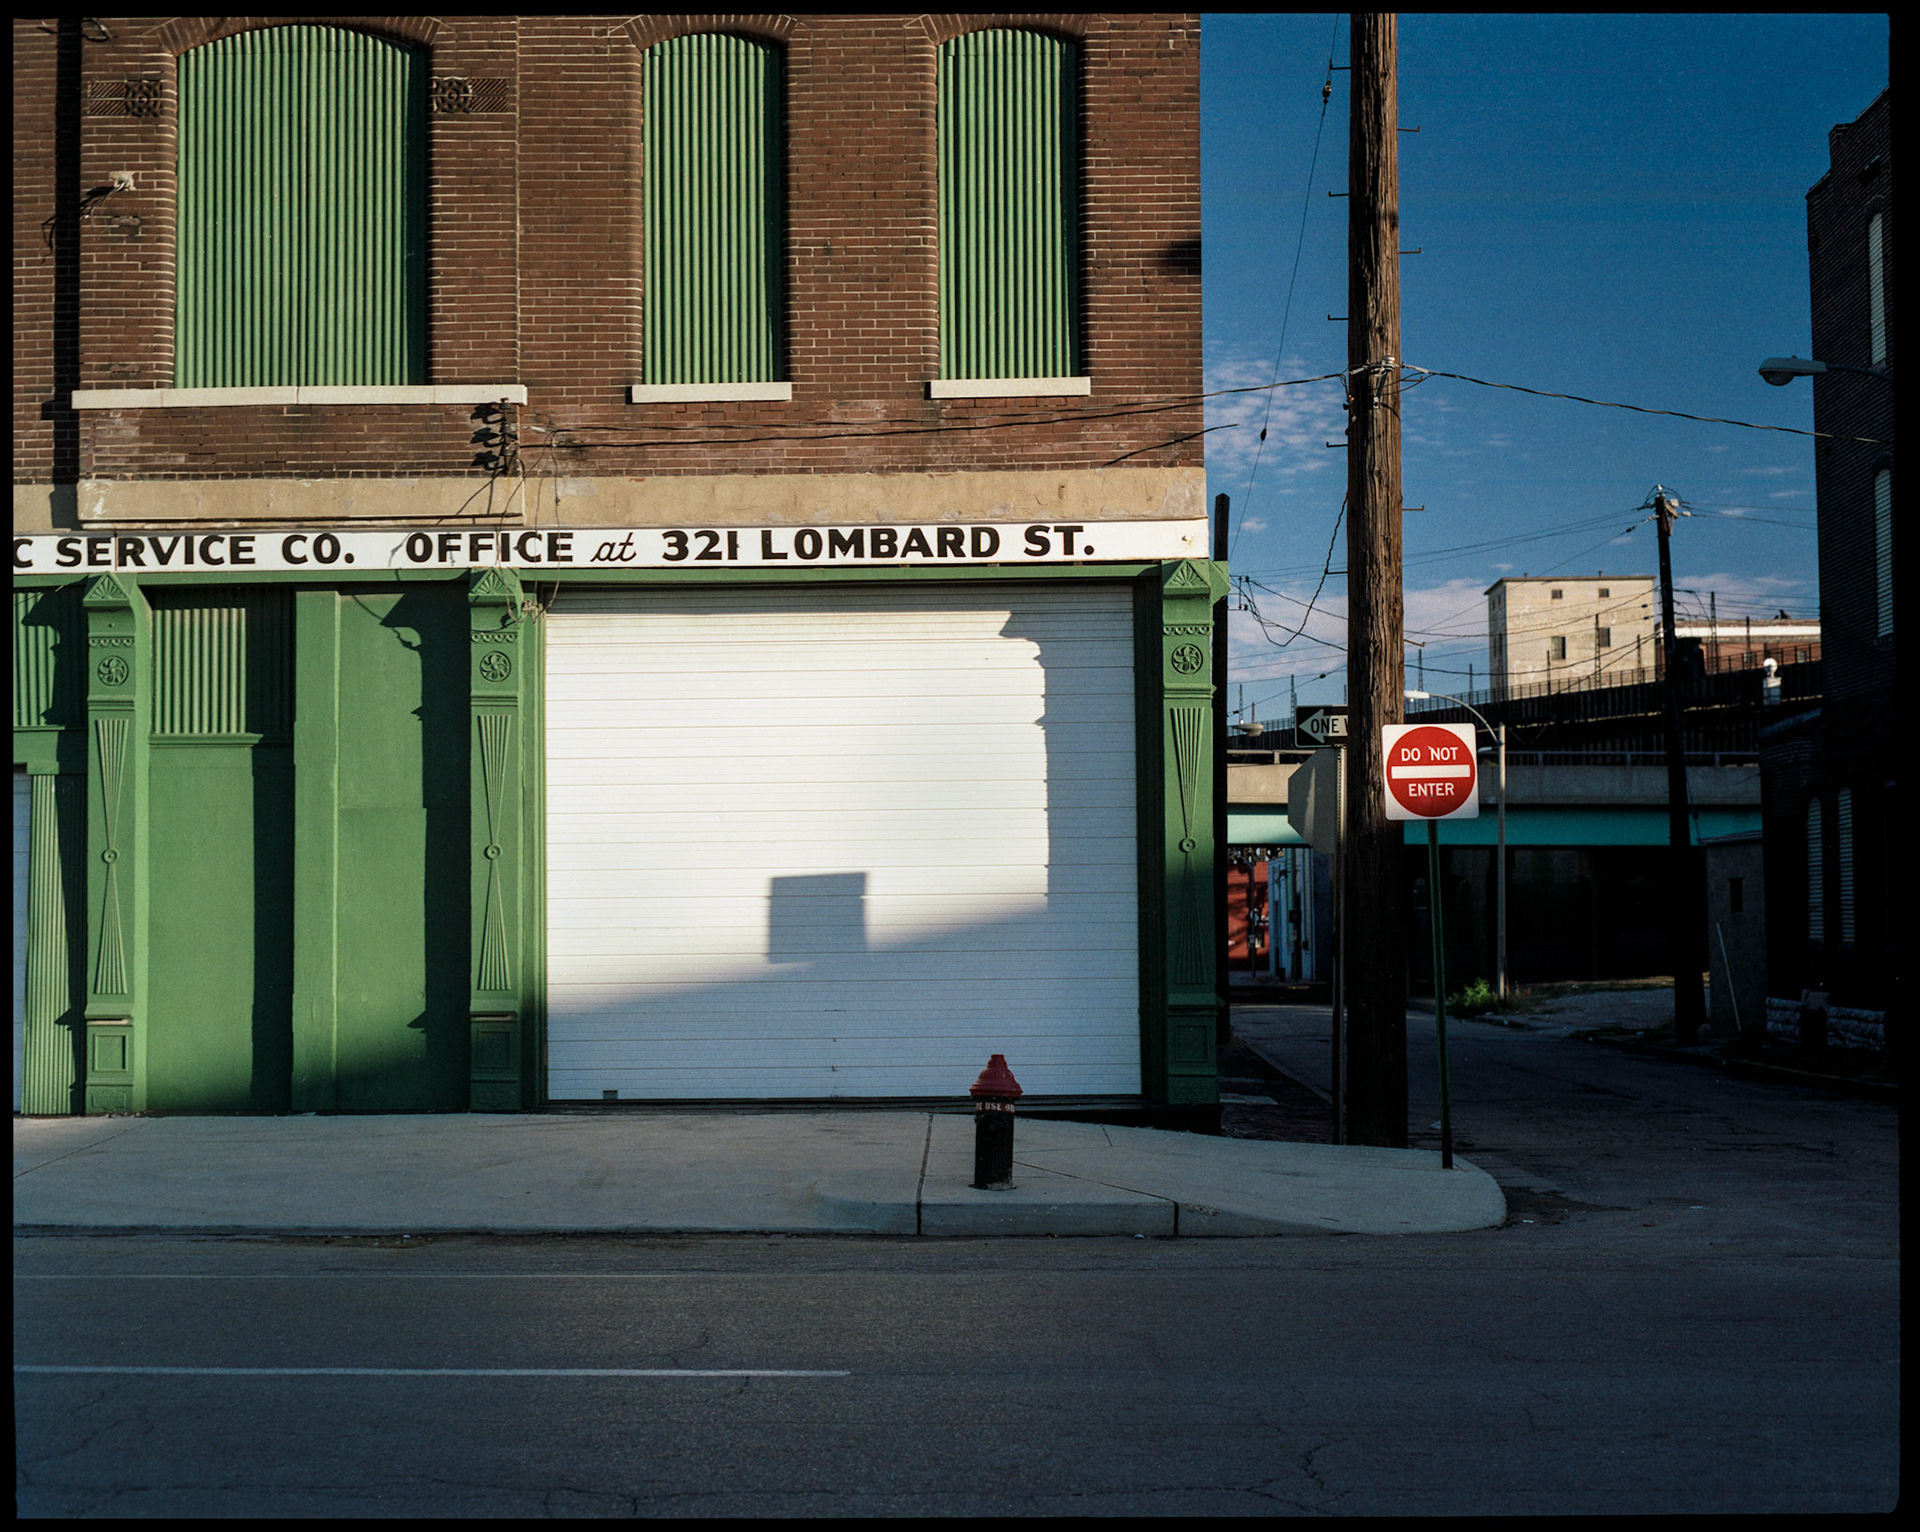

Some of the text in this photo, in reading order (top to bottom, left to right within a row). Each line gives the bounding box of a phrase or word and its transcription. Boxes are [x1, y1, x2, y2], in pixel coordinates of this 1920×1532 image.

[55, 534, 256, 568] SERVICE
[281, 533, 355, 565] CO.
[405, 531, 574, 564] OFFICE
[589, 531, 637, 563] at
[661, 530, 739, 562] 321
[761, 526, 1000, 560] LOMBARD
[1023, 524, 1095, 557] ST.
[1310, 718, 1340, 734] ONE
[1401, 746, 1459, 762] DO NOT
[1408, 783, 1455, 797] ENTER
[985, 1102, 1002, 1110] USE
